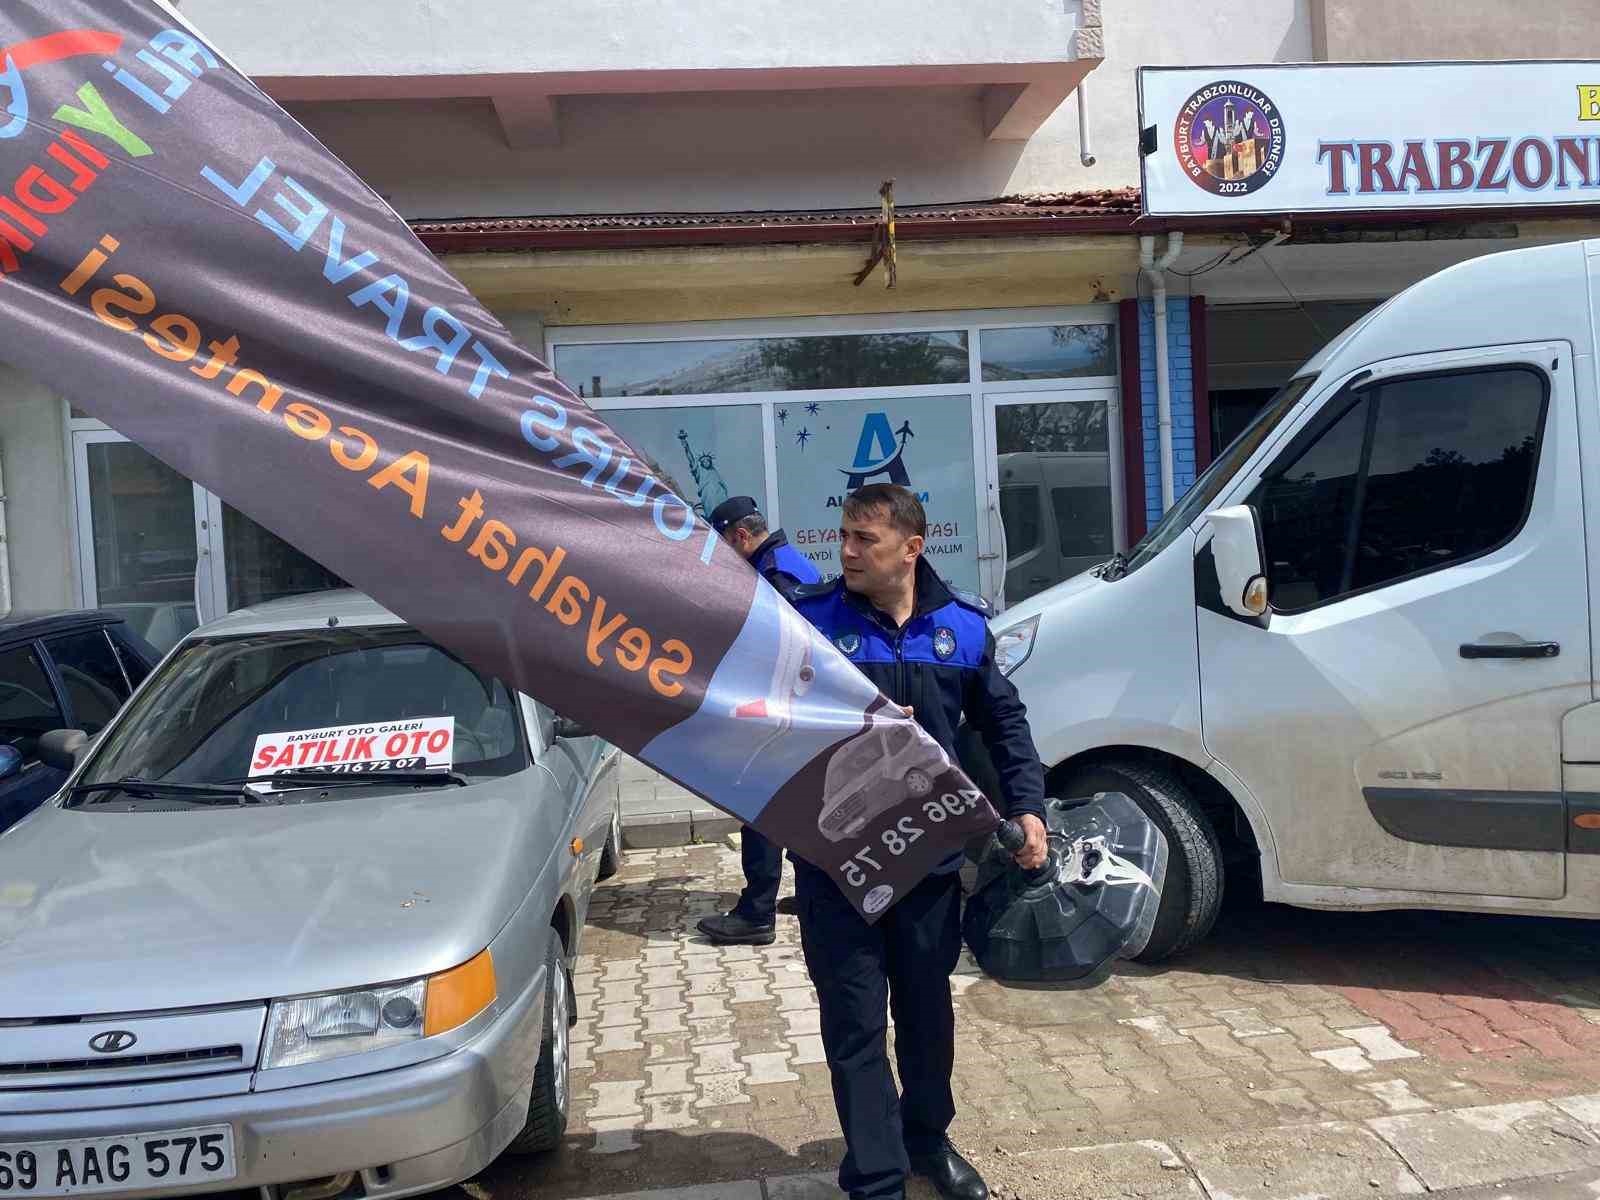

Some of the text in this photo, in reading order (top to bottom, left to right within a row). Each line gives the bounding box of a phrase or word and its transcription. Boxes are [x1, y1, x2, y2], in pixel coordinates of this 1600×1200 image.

[1178, 84, 1282, 177] BAYBURT TRABZONLULAR DERNEĞİ
[1316, 136, 1600, 195] TRABZON
[1219, 182, 1248, 193] 2022
[253, 729, 450, 770] SATILIK OTO
[287, 720, 424, 743] BAYBURT OTO GALERİ
[331, 763, 363, 774] 716
[368, 761, 391, 772] 72
[395, 758, 420, 769] 07
[0, 1134, 225, 1191] 69 AAG 575
